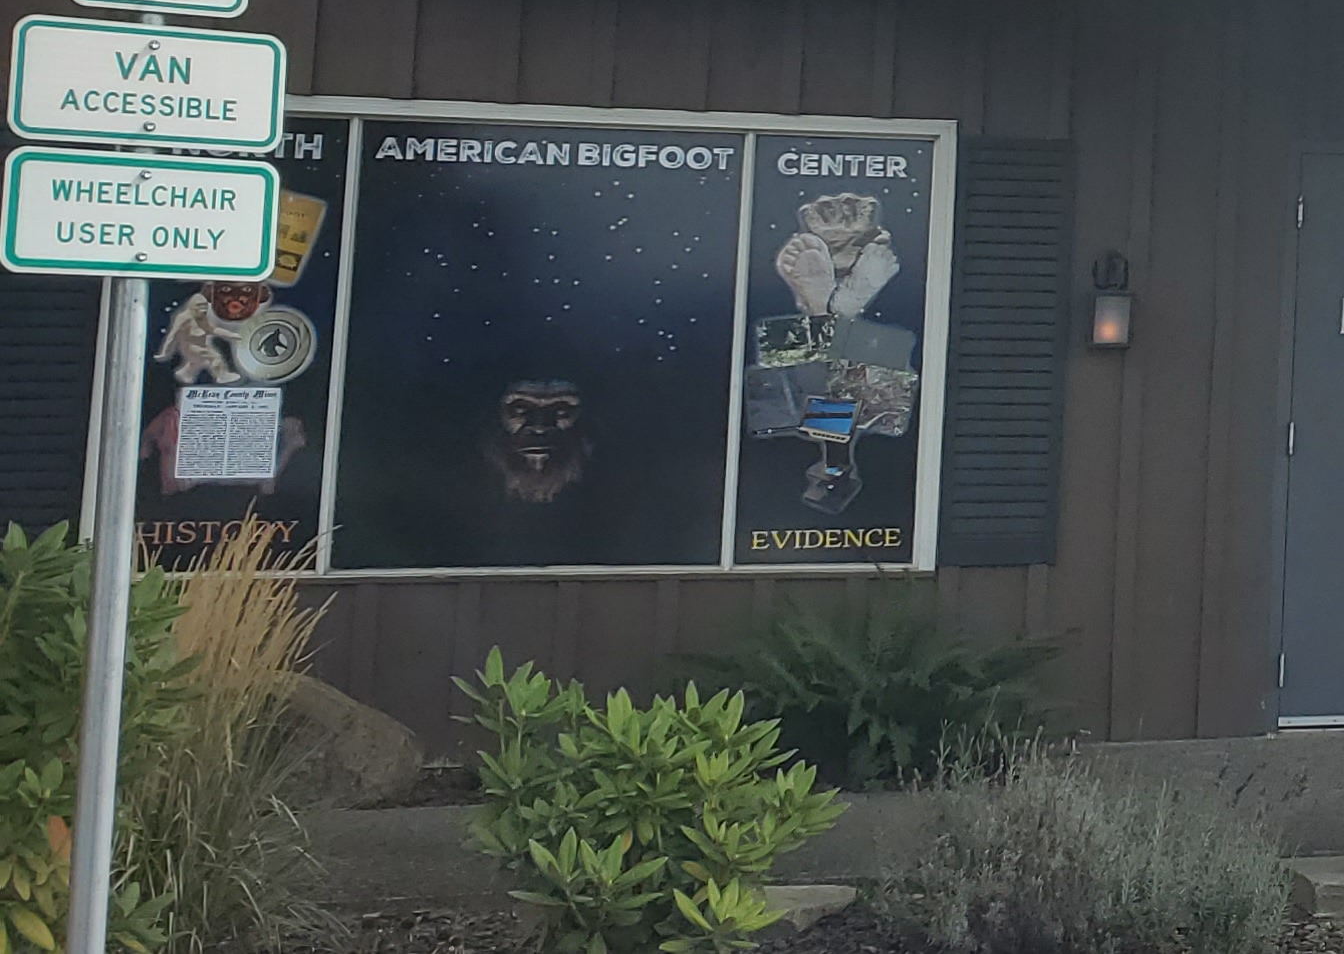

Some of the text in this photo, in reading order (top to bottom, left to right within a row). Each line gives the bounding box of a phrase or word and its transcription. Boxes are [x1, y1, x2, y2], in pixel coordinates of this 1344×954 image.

[115, 51, 192, 85] VAN
[60, 89, 238, 121] ACCESSIBLE
[375, 136, 908, 177] AMERICAN BIGFOOT CENTER
[51, 179, 237, 211] WHEELCHAIR
[56, 220, 226, 251] USER ONLY
[751, 527, 902, 551] EVIDENCE
